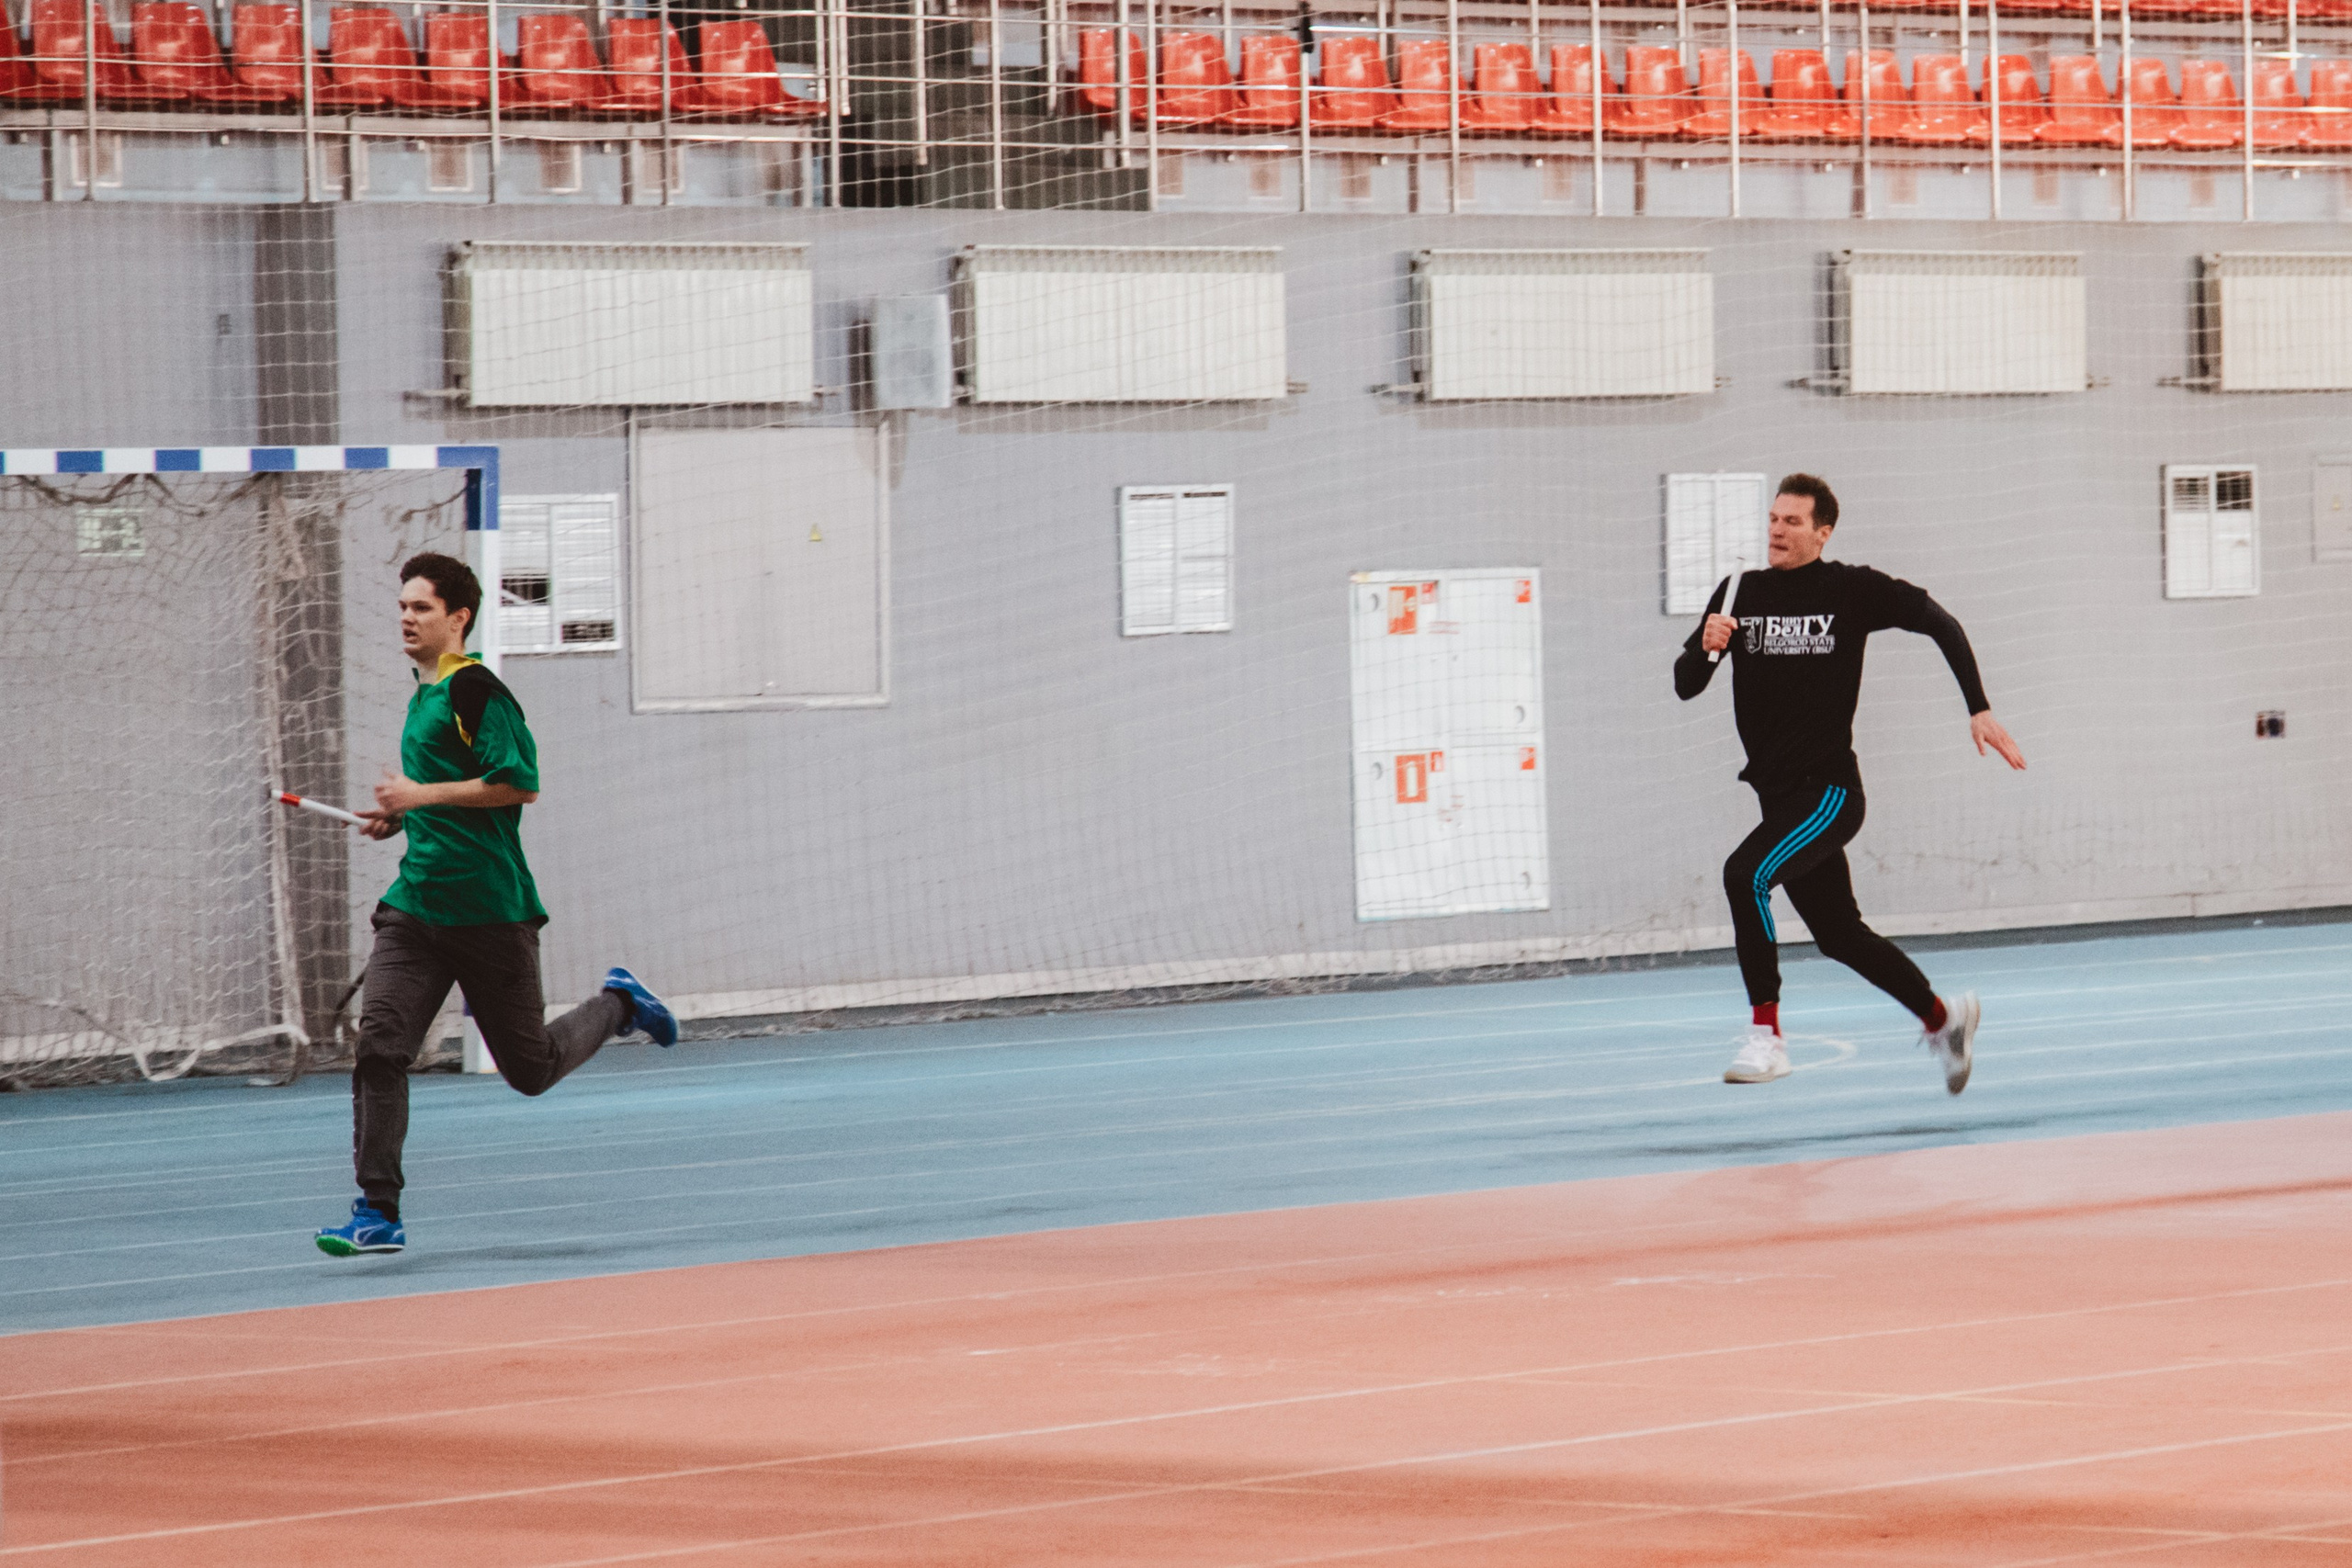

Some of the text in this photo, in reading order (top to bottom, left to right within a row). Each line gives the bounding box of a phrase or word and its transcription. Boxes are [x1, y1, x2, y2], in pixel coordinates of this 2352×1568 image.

[1765, 615, 1835, 637] БелГУ
[1764, 636, 1836, 647] BELGOROD STATE
[1764, 646, 1811, 655] UNIVERSITY
